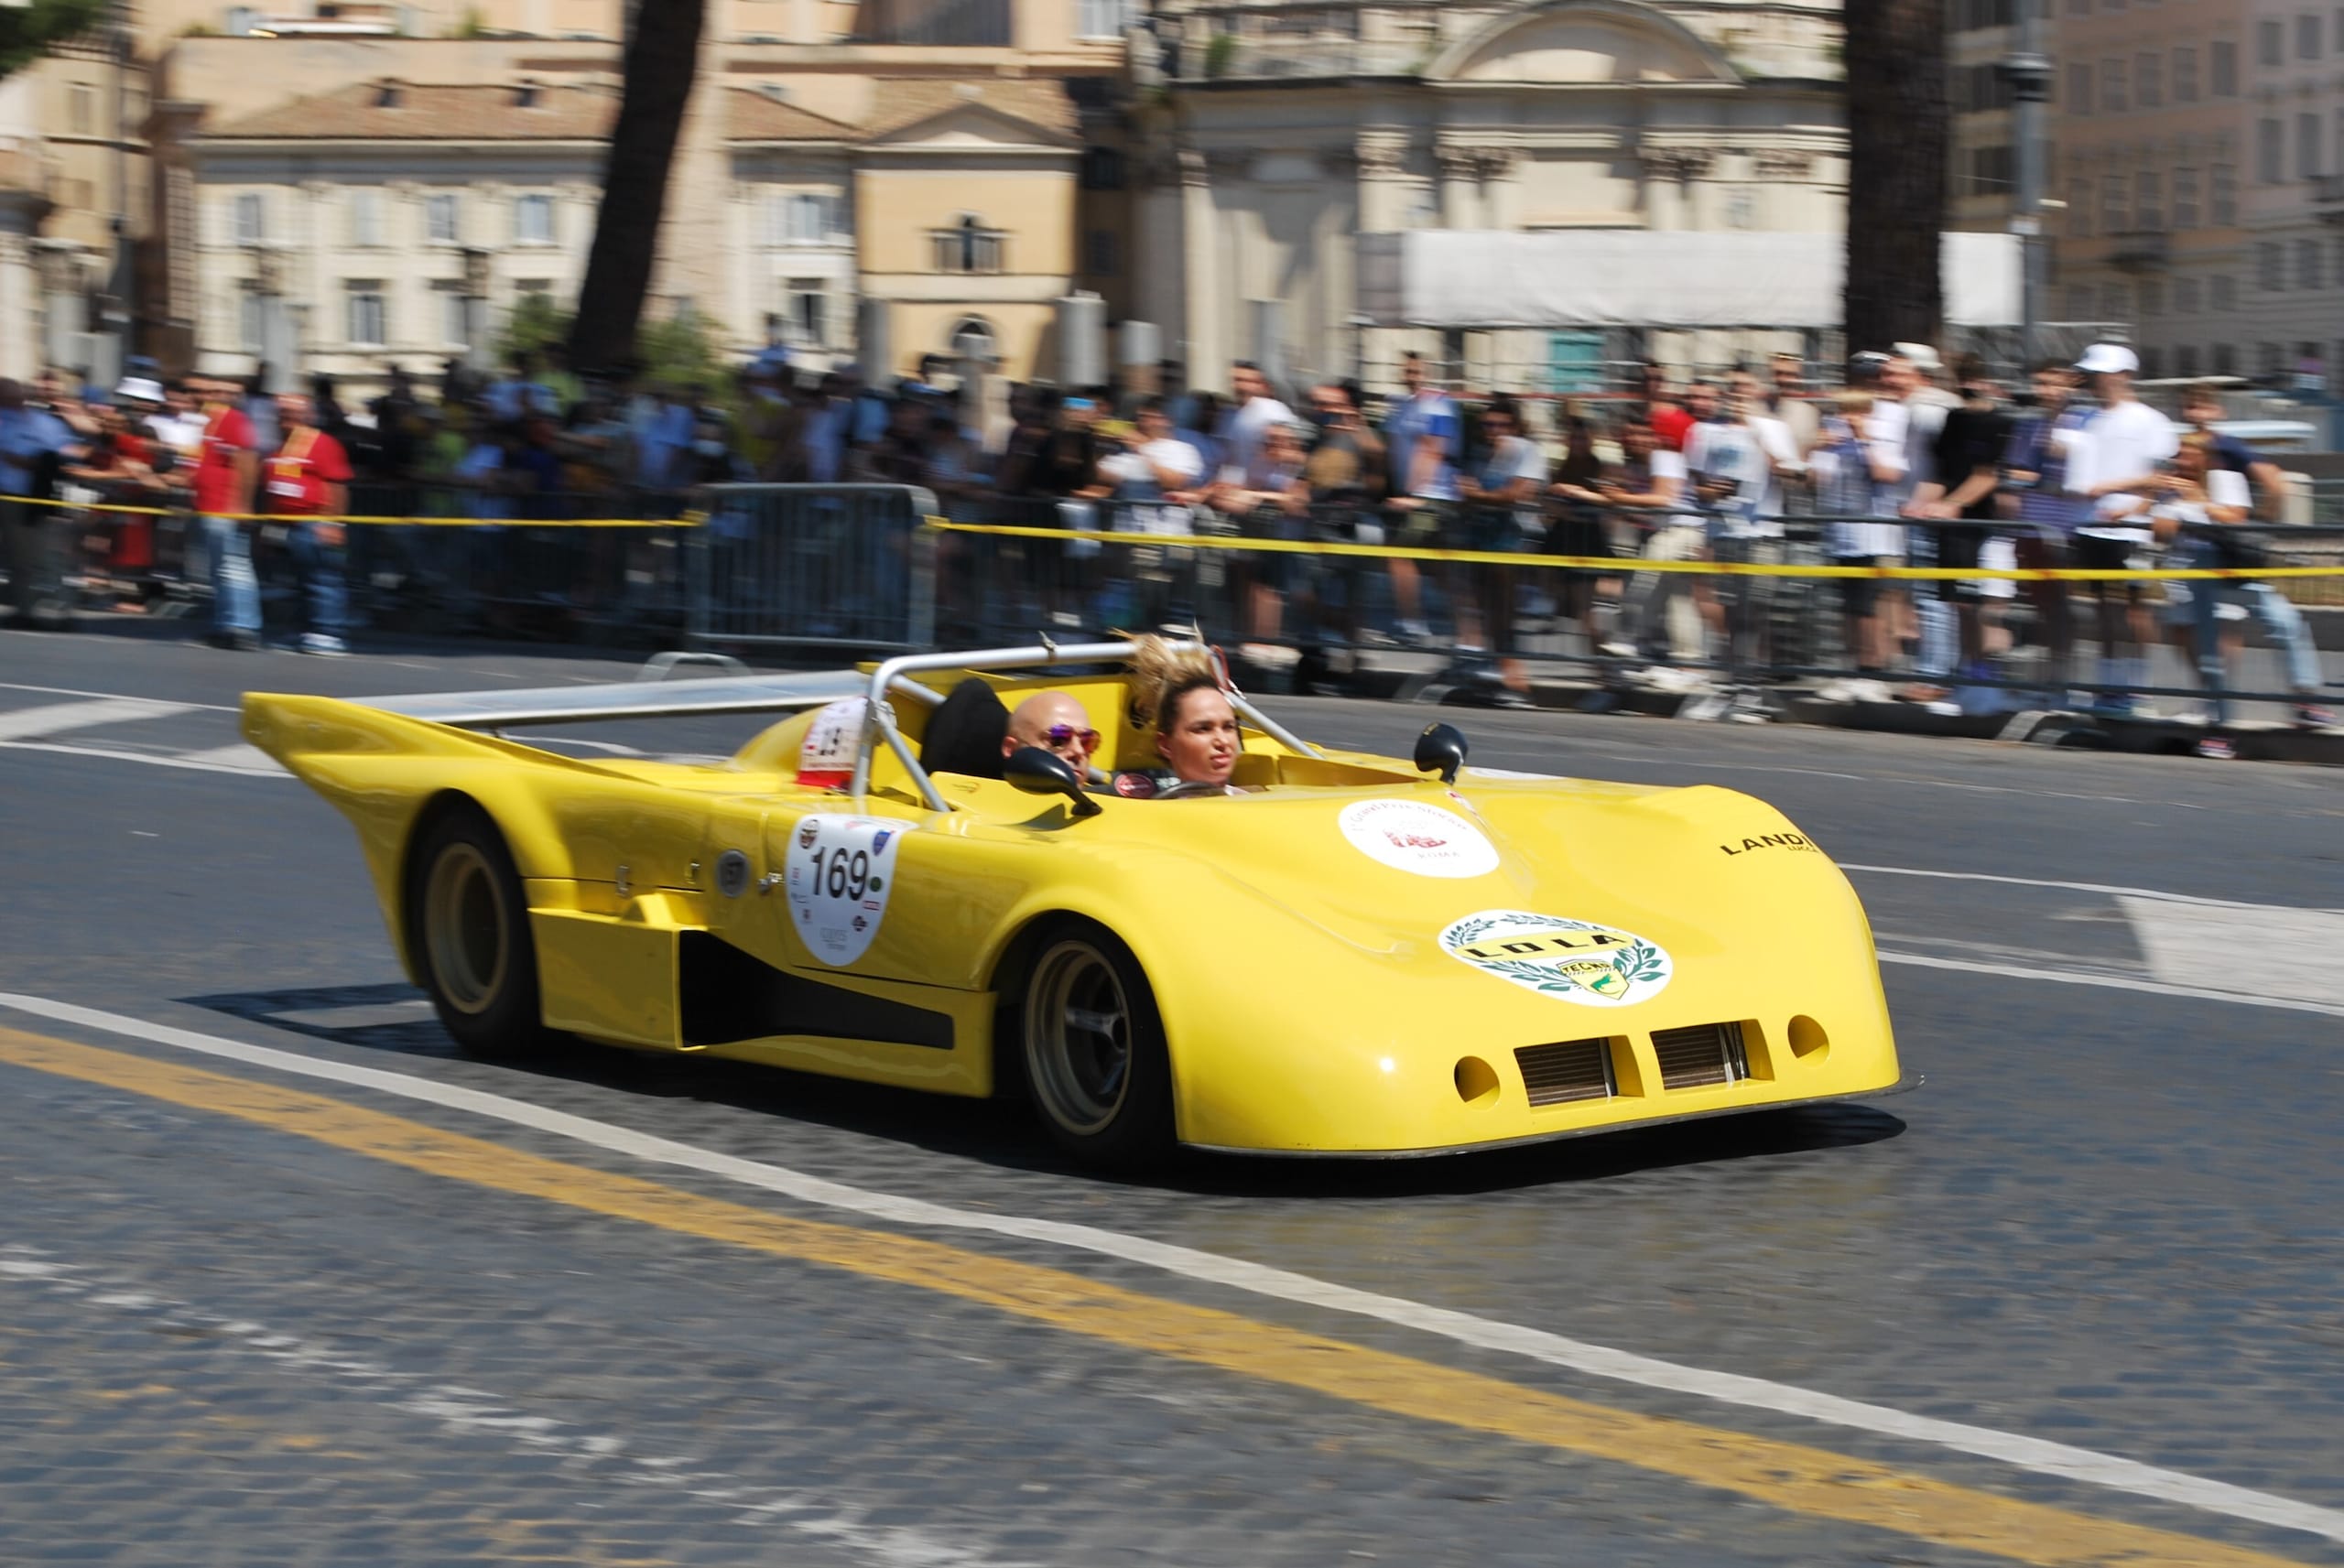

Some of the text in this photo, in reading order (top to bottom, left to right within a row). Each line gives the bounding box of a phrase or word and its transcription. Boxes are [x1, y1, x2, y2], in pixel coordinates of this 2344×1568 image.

[1720, 833, 1813, 855] LANDI
[811, 847, 868, 901] 169
[1464, 935, 1626, 957] LOLA
